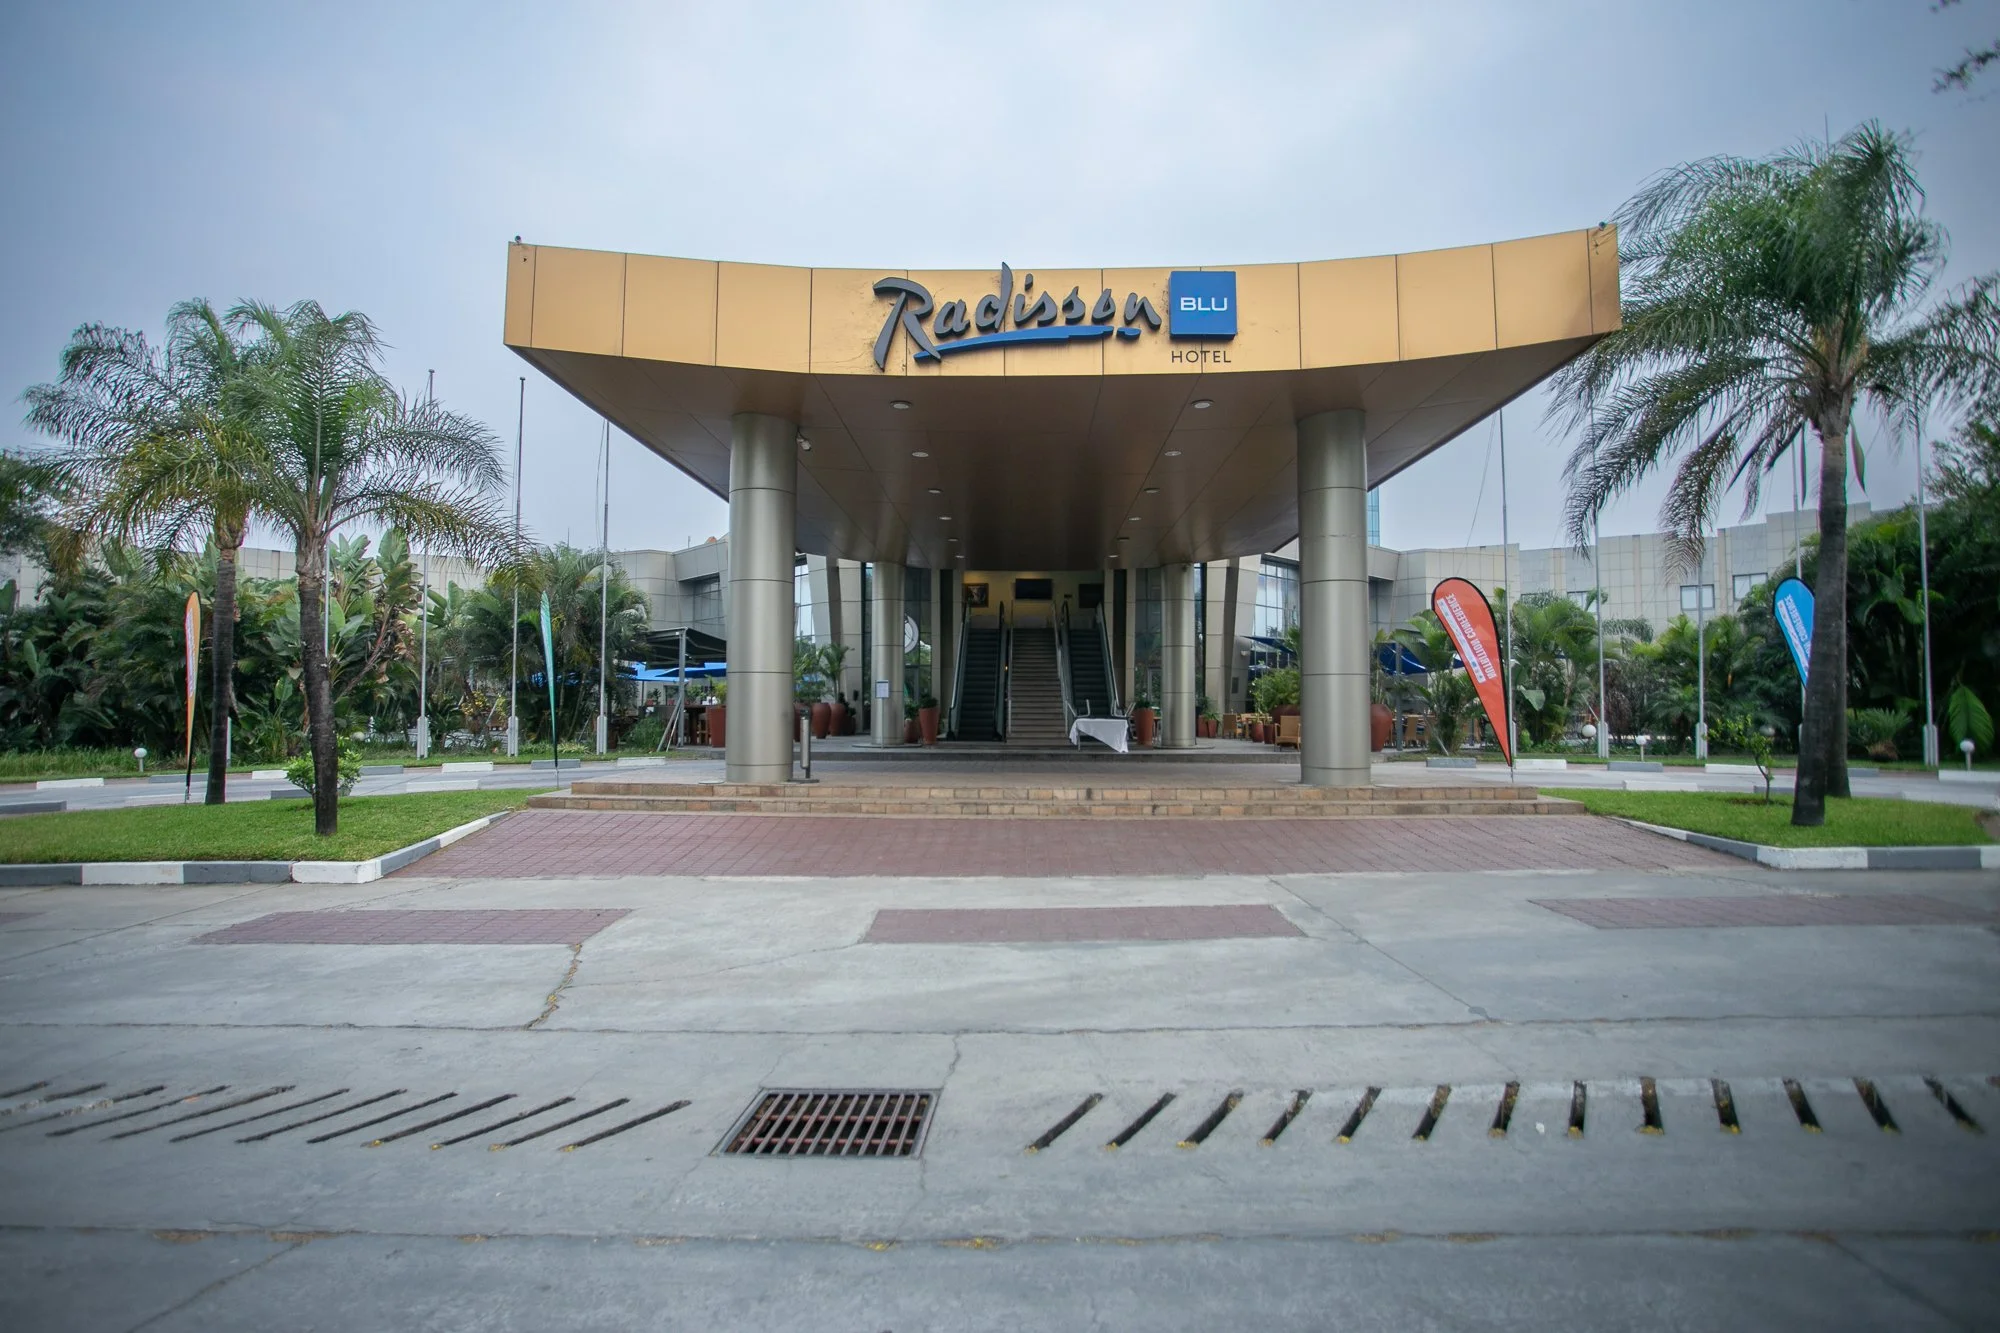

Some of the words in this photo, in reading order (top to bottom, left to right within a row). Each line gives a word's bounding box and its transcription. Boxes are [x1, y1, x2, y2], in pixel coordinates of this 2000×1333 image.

[873, 262, 1162, 372] Radisson
[1180, 297, 1228, 311] BLU
[1171, 350, 1232, 363] HOTEL
